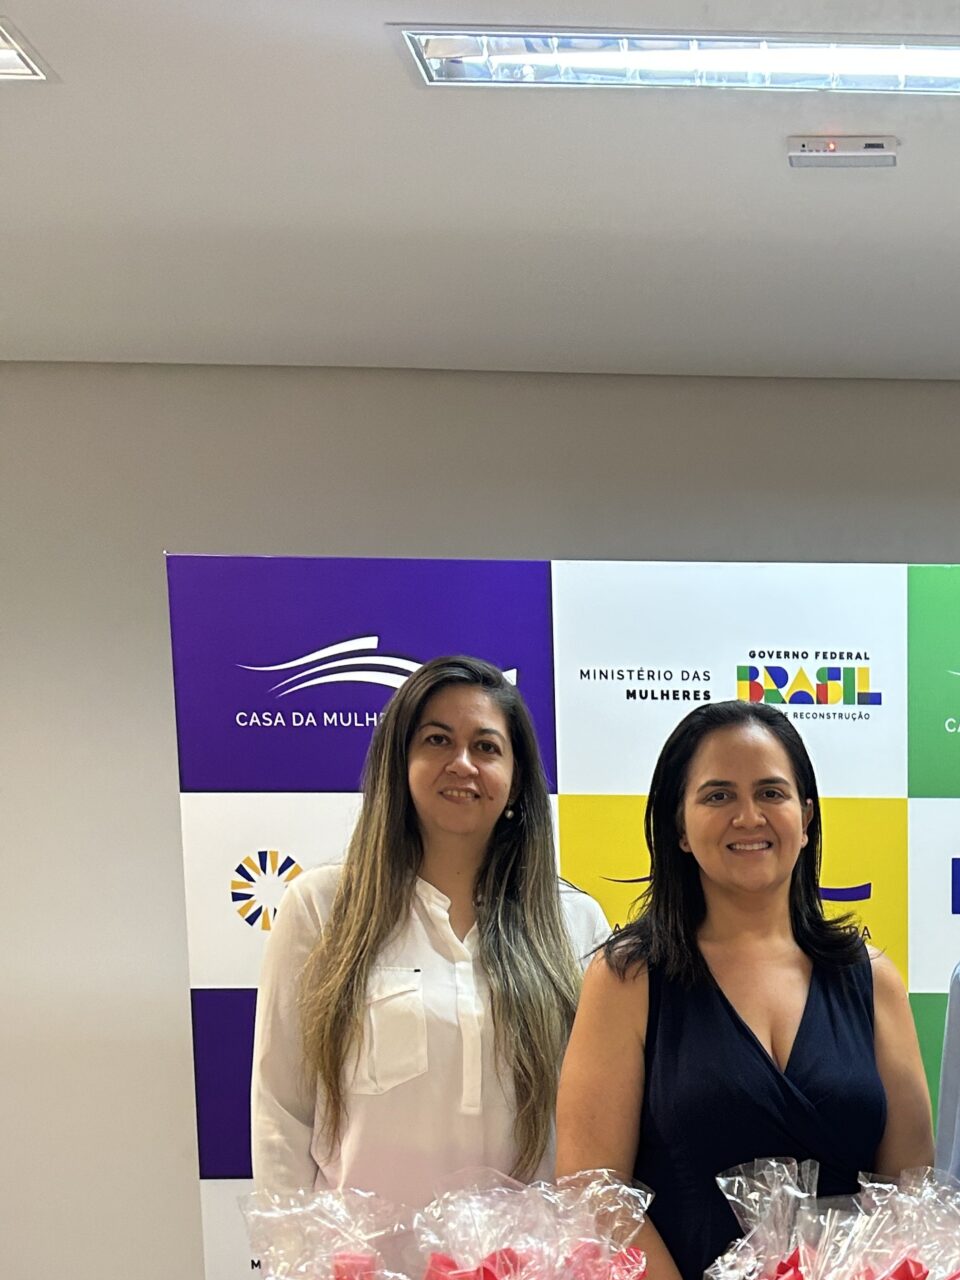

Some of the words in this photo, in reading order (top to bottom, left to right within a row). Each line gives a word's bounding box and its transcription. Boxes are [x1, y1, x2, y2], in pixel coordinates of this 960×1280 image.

[749, 650, 809, 660] GOVERNO
[815, 650, 871, 660] FEDERAL
[580, 667, 673, 681] MINISTÉRIO
[681, 671, 712, 681] DAS
[737, 665, 882, 705] BRASIL
[626, 689, 711, 701] MULHERES
[235, 712, 286, 727] CASA
[292, 712, 317, 727] DA
[324, 712, 384, 727] MULH
[793, 711, 871, 721] RECONSTRUÇÃO
